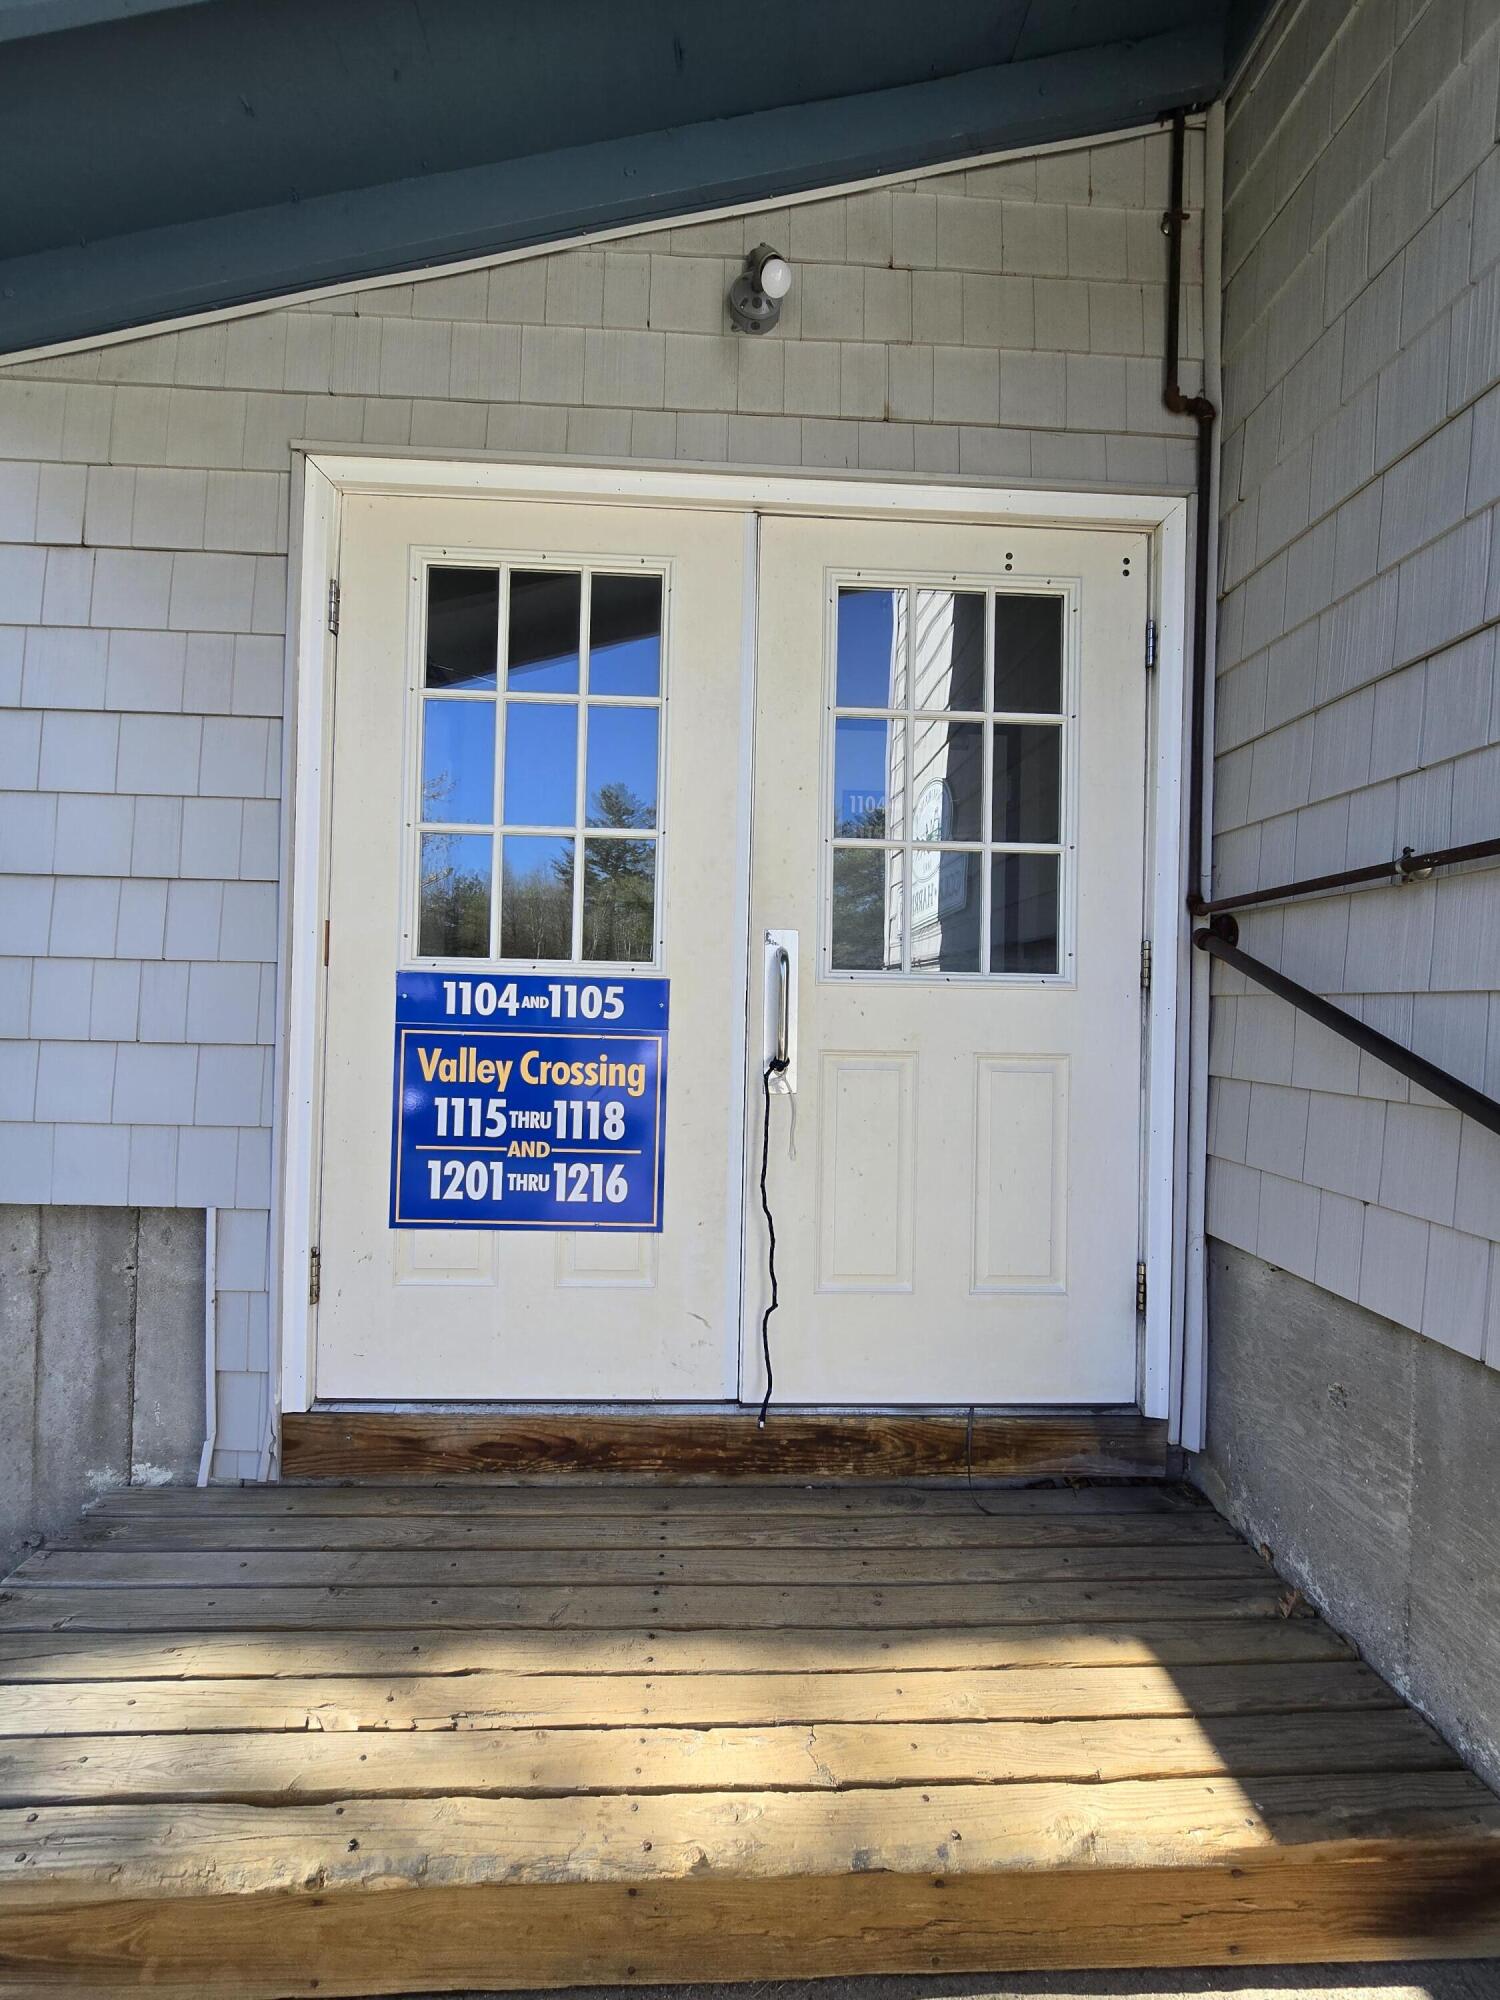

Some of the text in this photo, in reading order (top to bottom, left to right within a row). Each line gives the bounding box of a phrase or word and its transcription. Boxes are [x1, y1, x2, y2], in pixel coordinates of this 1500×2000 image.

[443, 981, 625, 1019] 1104 AND 1105
[417, 1046, 646, 1097] Valley Crossing
[434, 1097, 625, 1140] 1115 THRU 1118
[507, 1140, 550, 1158] AND
[427, 1160, 628, 1203] 1201 THRU 1216
